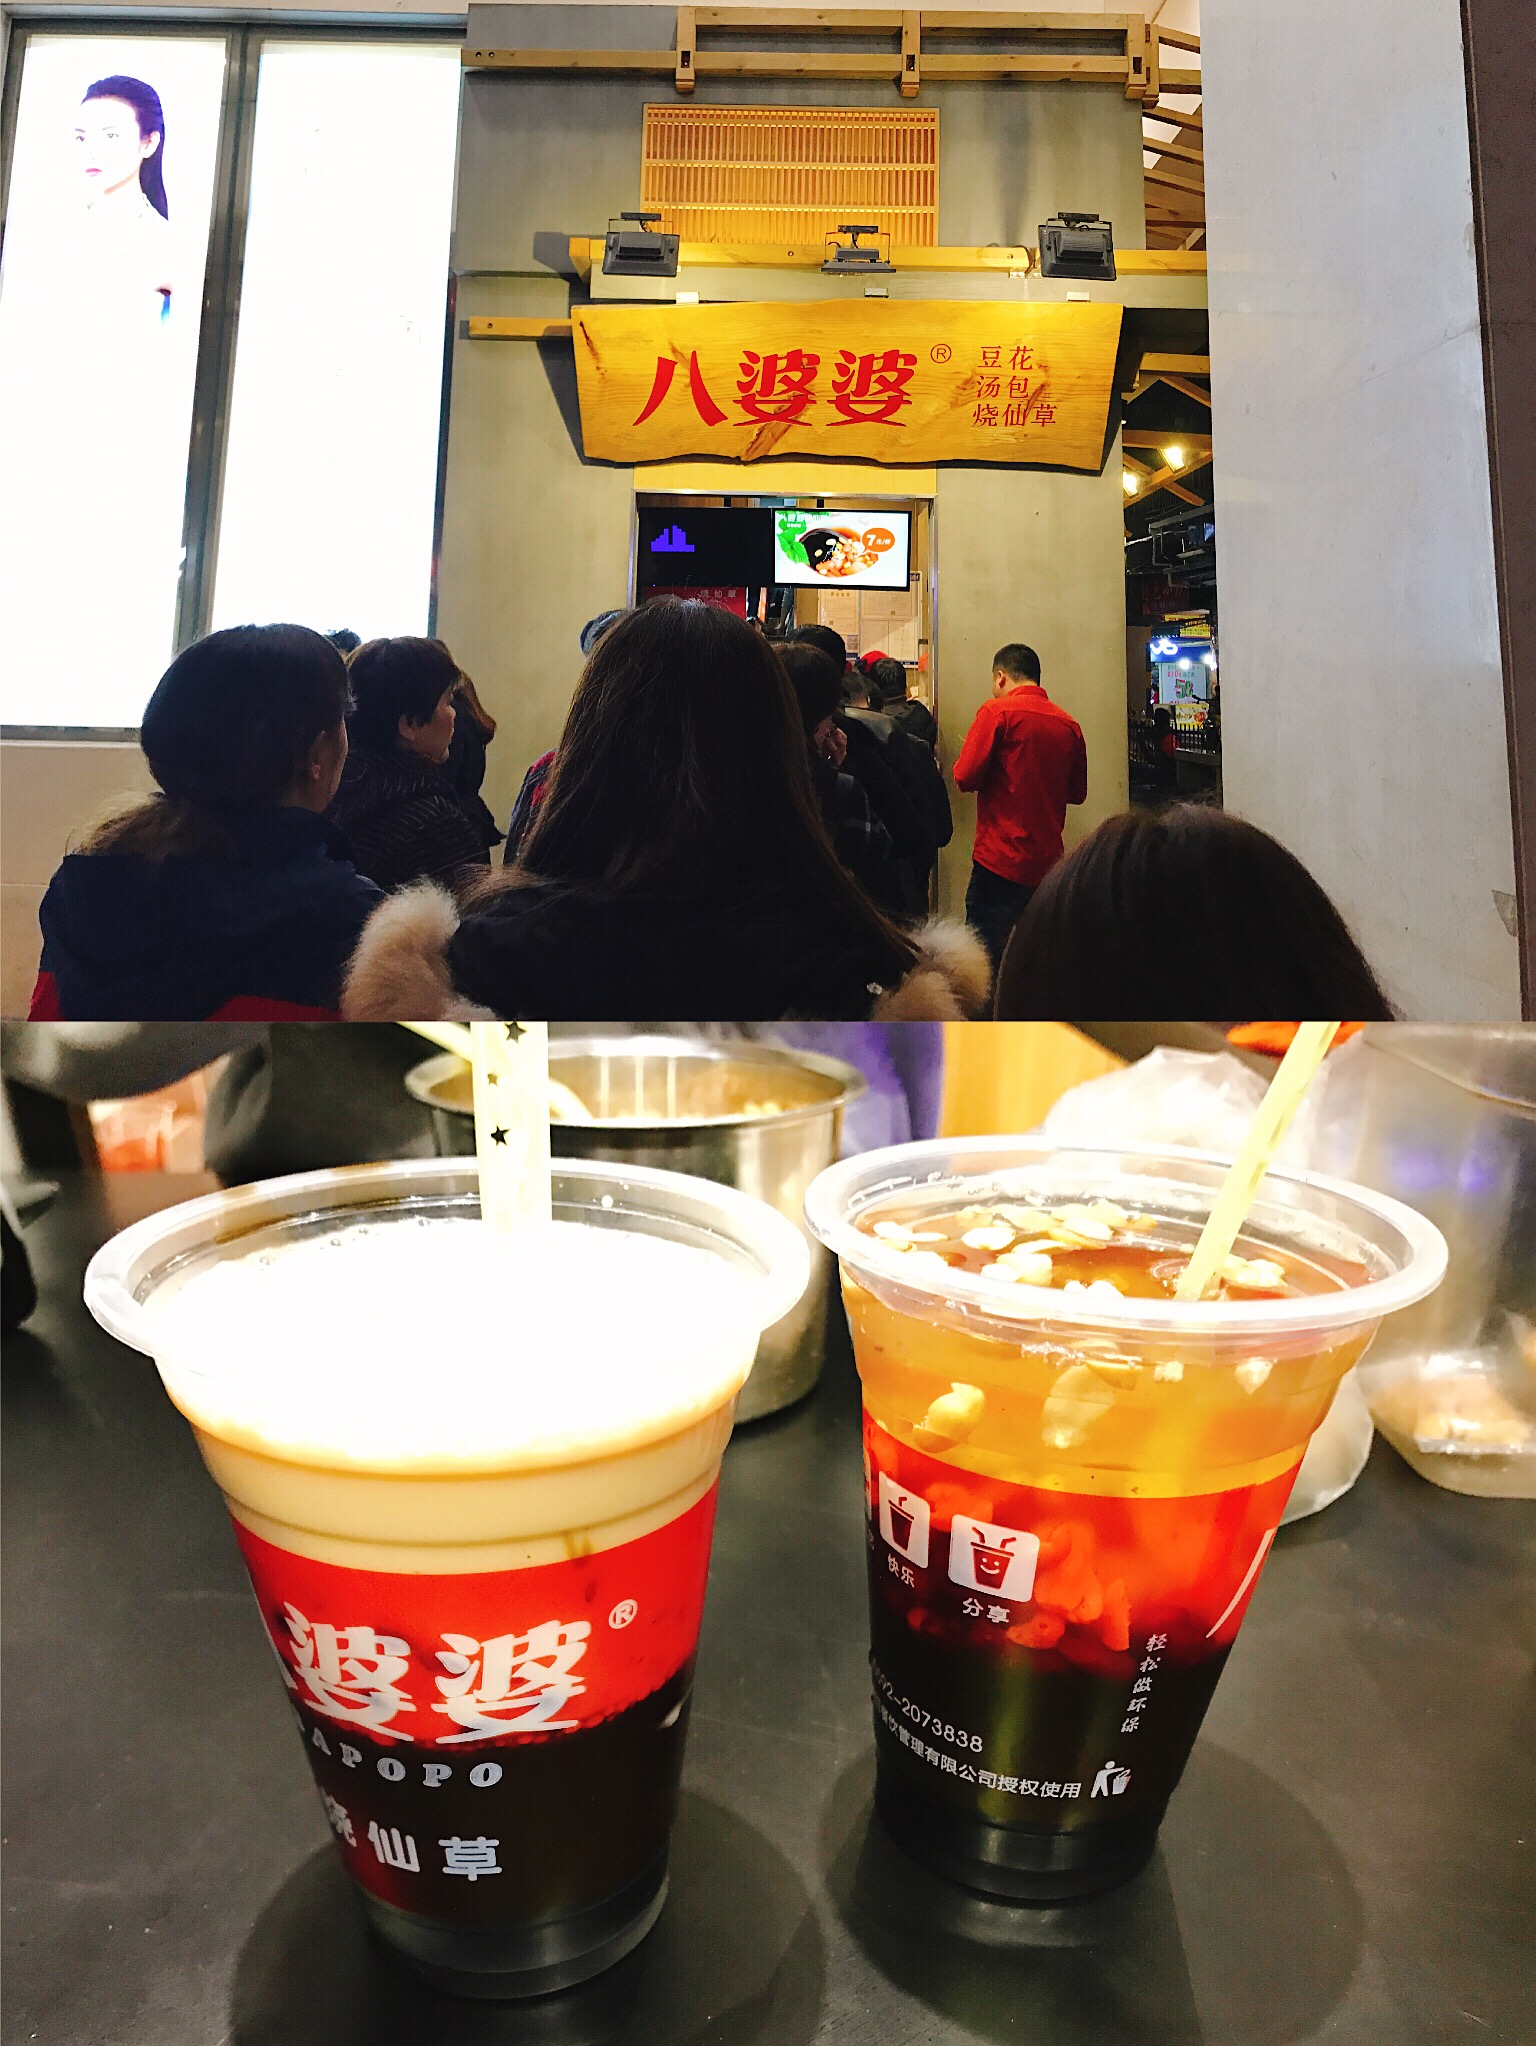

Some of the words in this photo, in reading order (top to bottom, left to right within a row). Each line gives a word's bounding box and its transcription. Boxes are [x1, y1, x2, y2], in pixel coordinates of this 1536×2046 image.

[979, 345, 1034, 372] 豆花
[632, 348, 918, 427] 八婆婆
[971, 402, 1058, 428] 烧仙草
[975, 375, 1030, 399] 汤包
[887, 1553, 915, 1589] 快乐
[962, 1597, 1010, 1624] 分享
[268, 1601, 592, 1744] 婆婆
[1120, 1633, 1168, 1733] 轻松做环保
[874, 1660, 984, 1753] 92-2073838
[298, 1712, 503, 1788] APOPO
